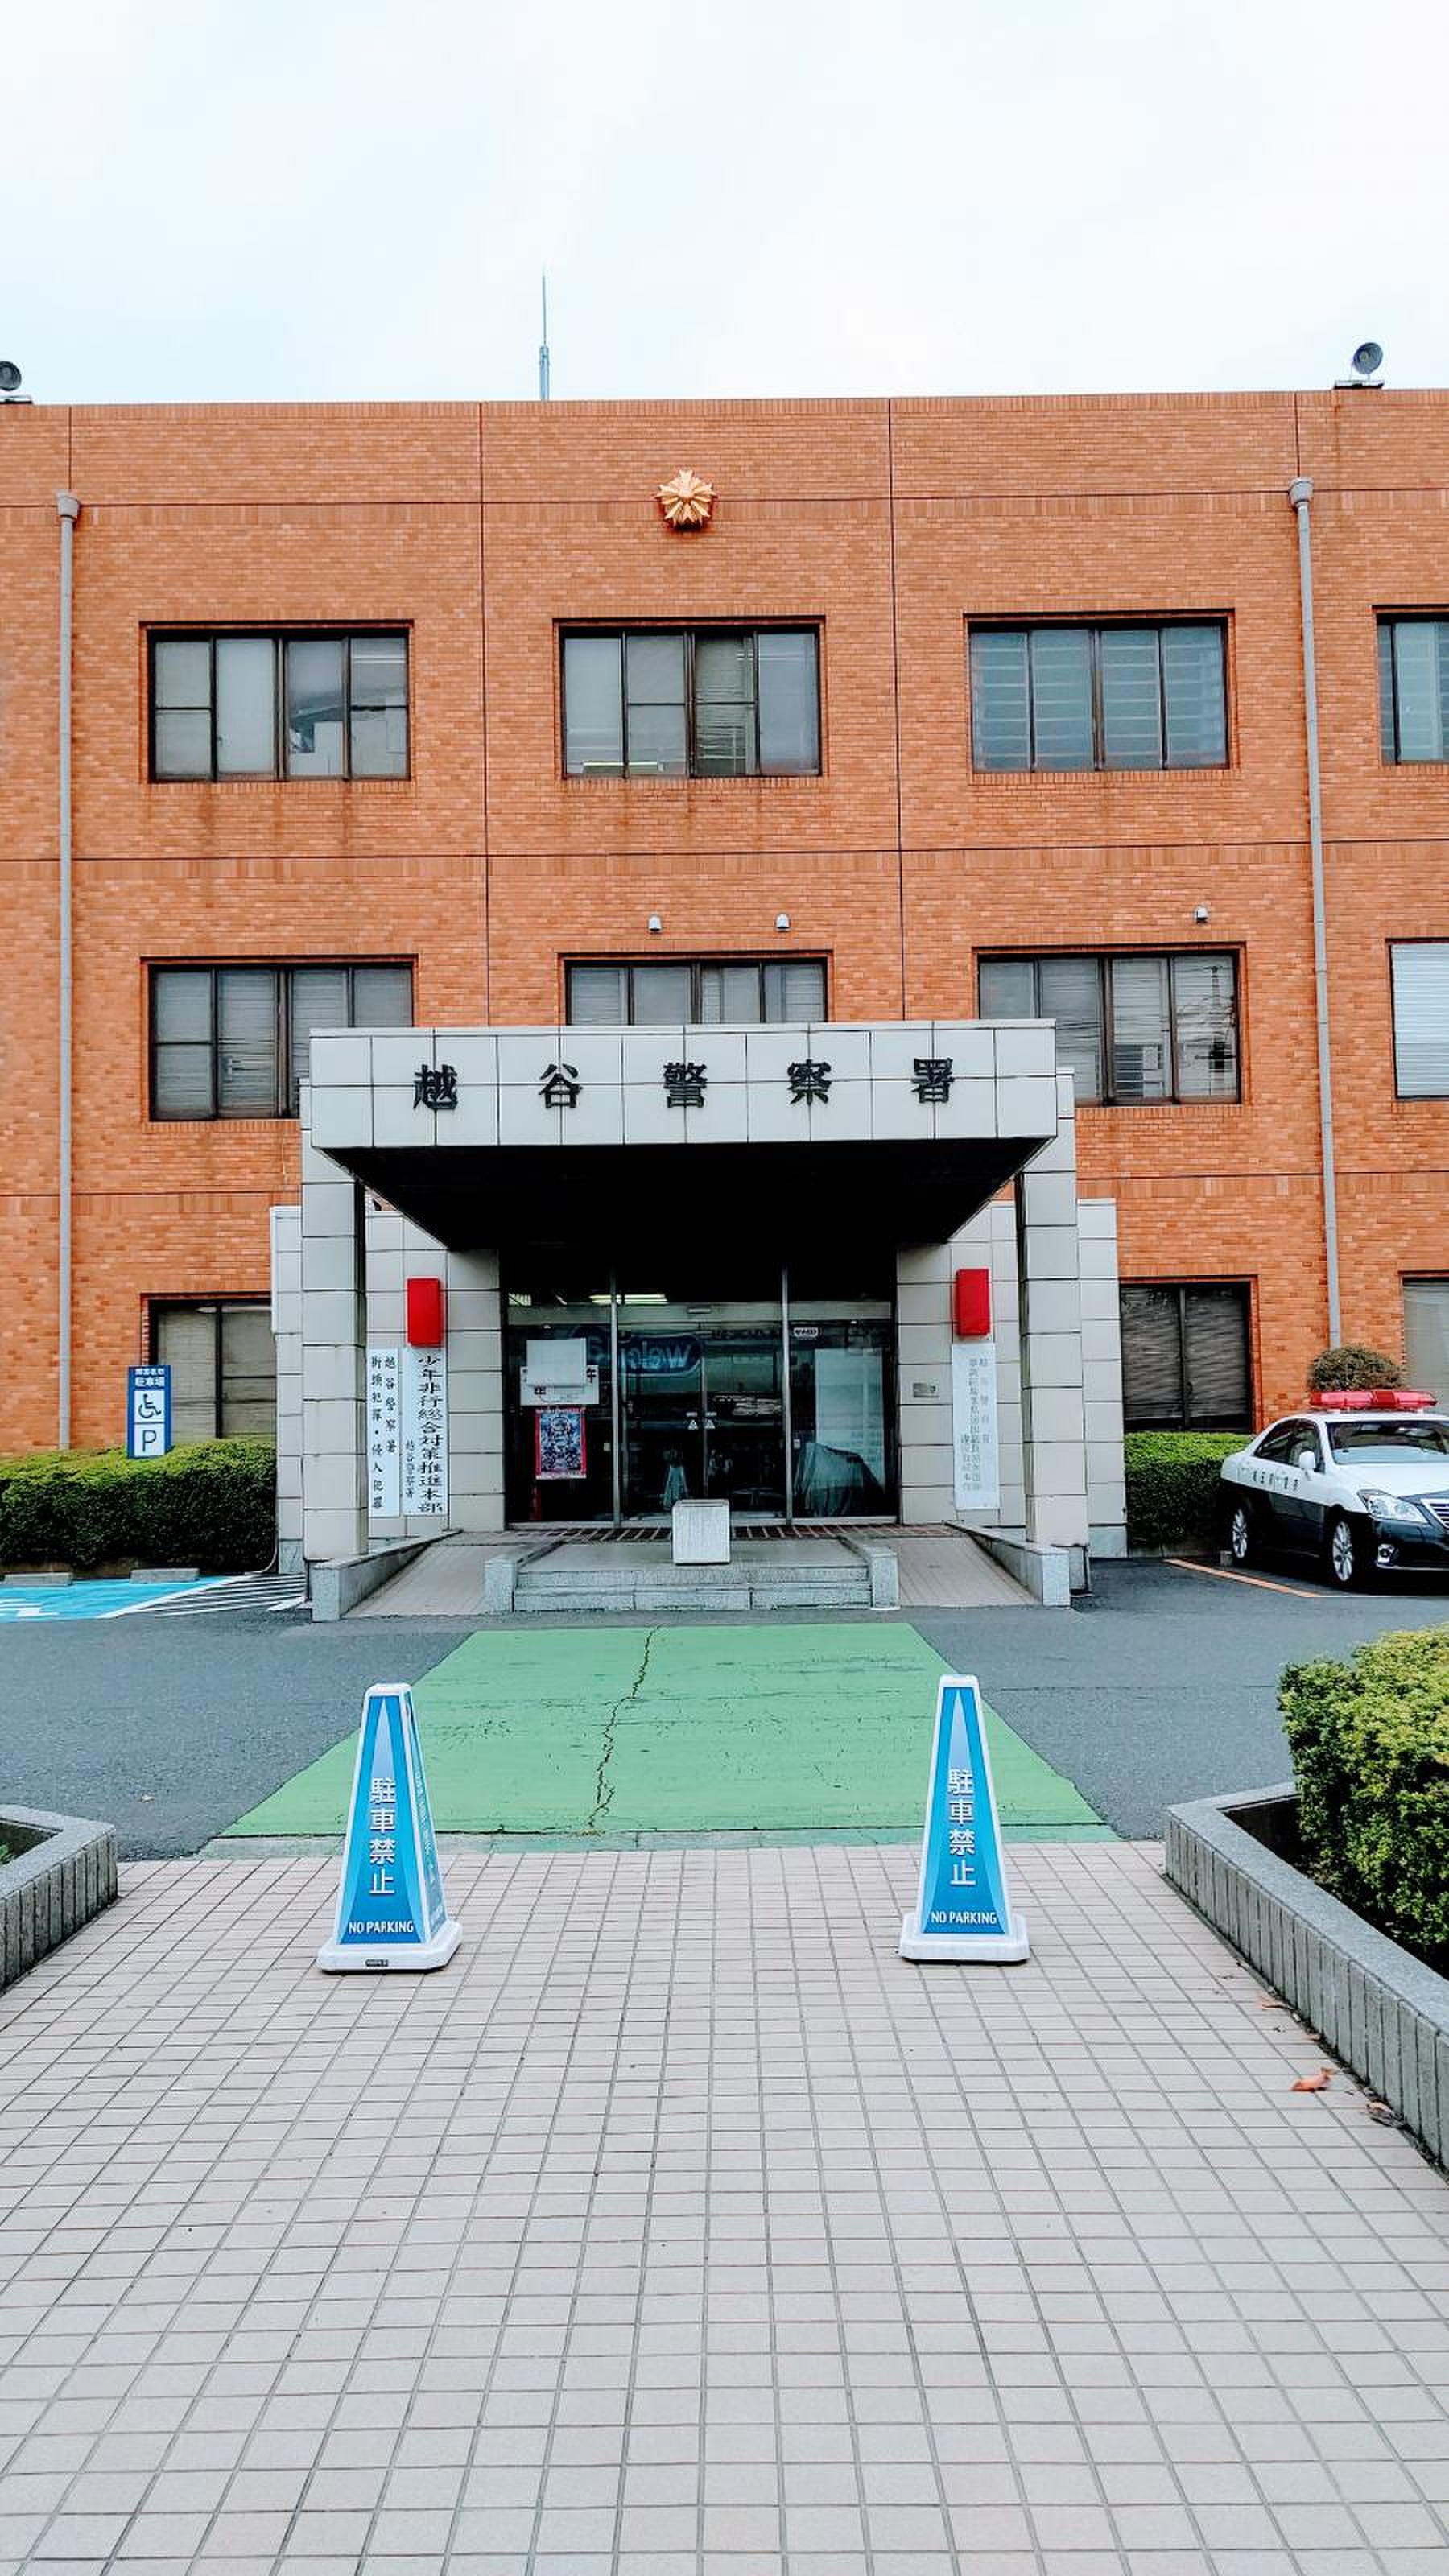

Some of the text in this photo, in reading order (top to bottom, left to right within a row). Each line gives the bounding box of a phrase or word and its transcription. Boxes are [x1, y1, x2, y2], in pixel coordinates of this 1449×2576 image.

[413, 1058, 955, 1110] 越谷警察署
[142, 1429, 157, 1453] P
[418, 1356, 444, 1513] 少年非行総合対策推進本部
[369, 1777, 396, 1896] 駐車禁止
[947, 1768, 976, 1886] 駐車禁止
[348, 1919, 414, 1934] NO PARKING
[931, 1910, 997, 1924] NO PARKING
